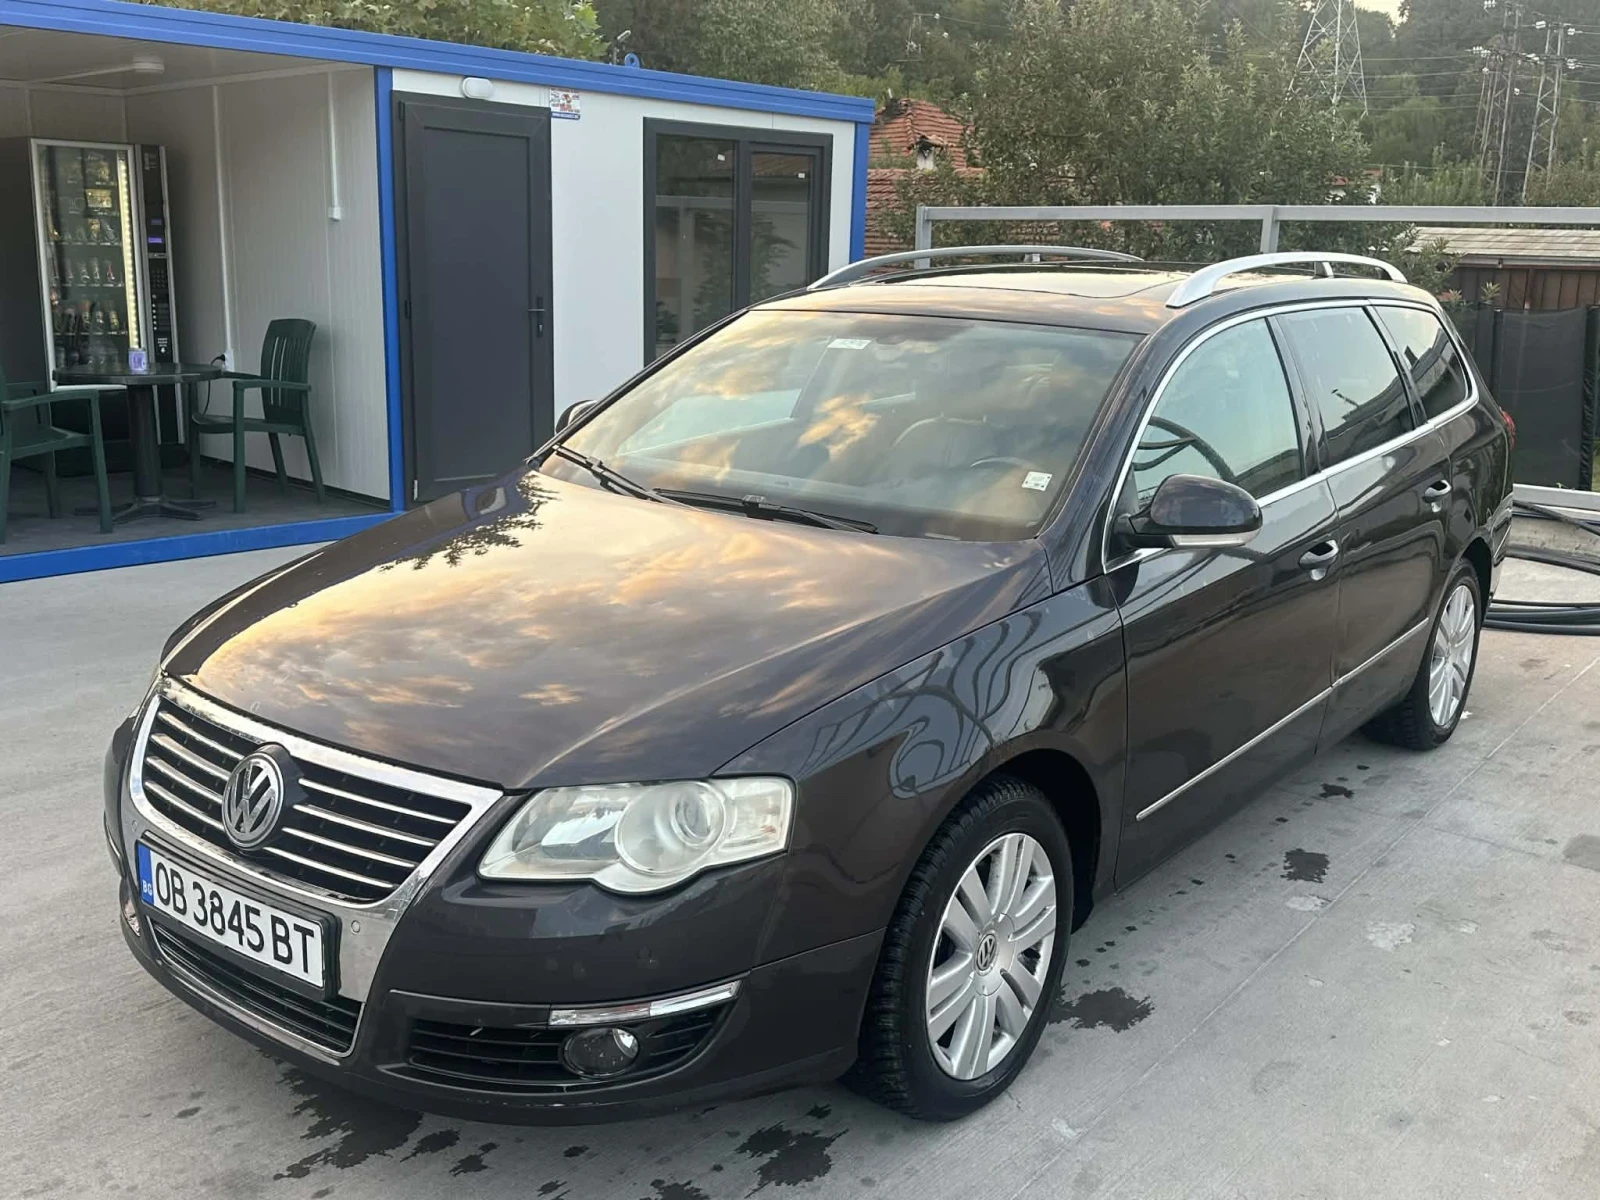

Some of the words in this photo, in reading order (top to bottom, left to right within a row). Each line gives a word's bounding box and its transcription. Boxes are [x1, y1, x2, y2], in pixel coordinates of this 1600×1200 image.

[225, 756, 279, 843] VW
[142, 879, 153, 897] BG
[155, 861, 188, 916] OB
[192, 881, 265, 953] 3845
[271, 915, 315, 975] BT
